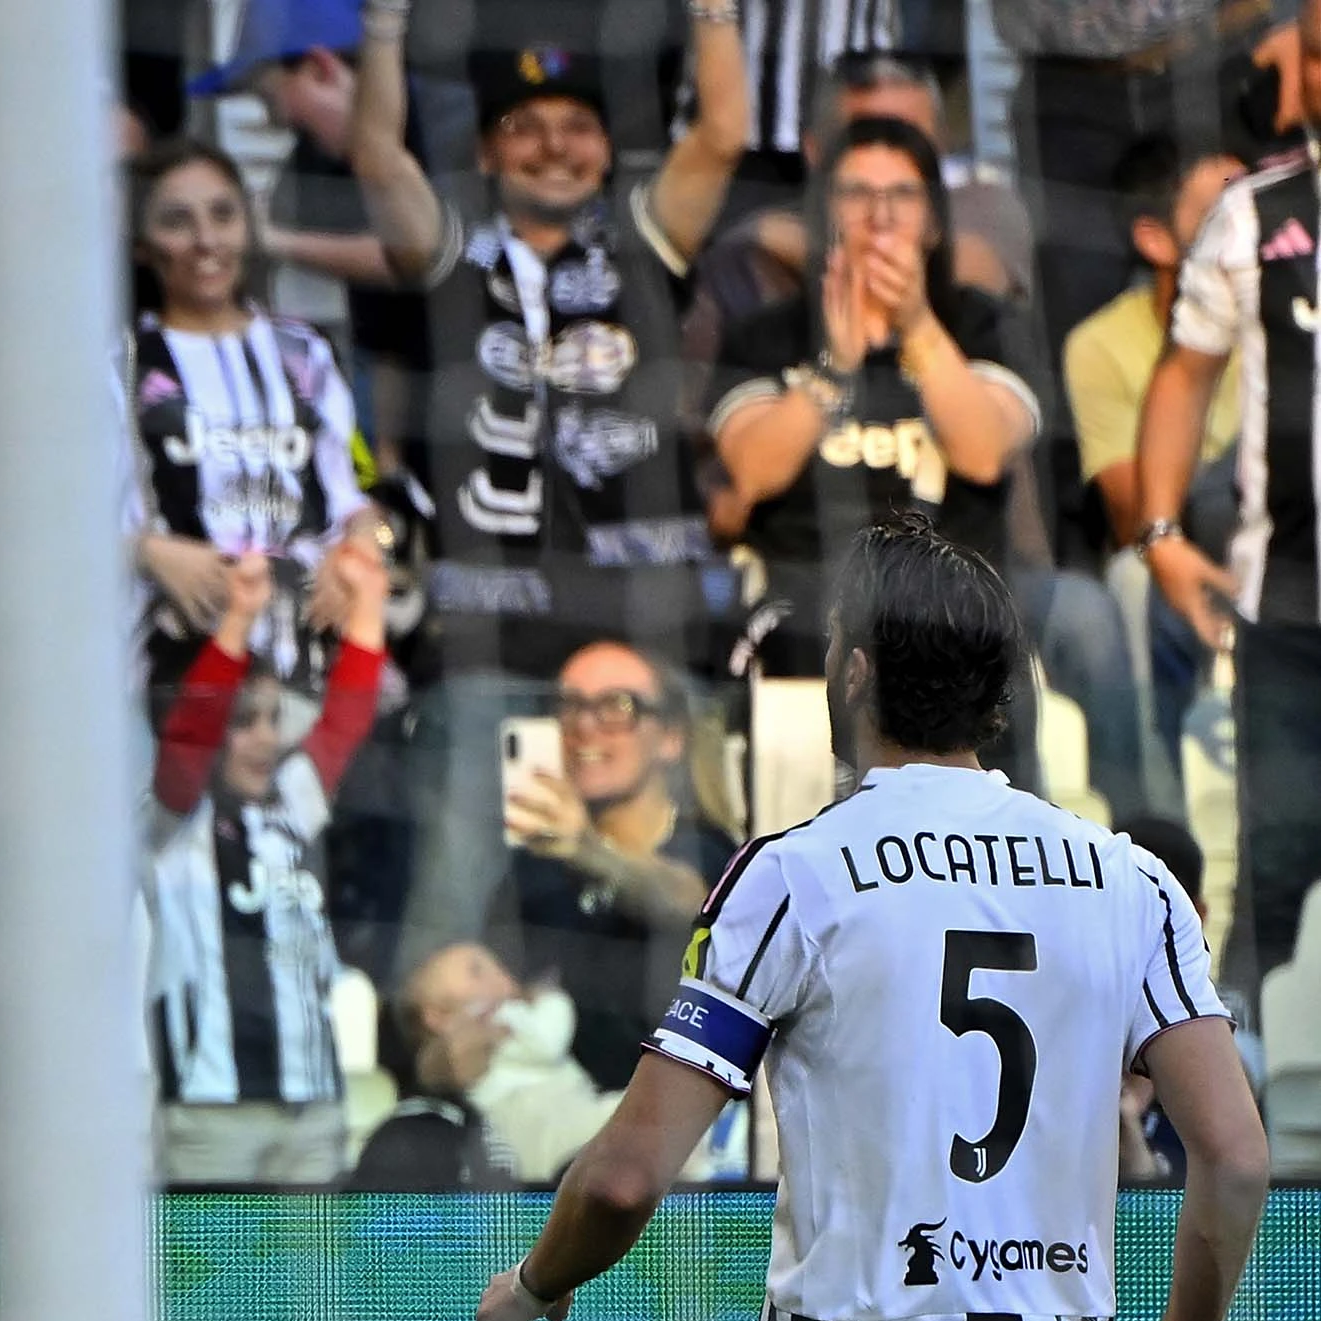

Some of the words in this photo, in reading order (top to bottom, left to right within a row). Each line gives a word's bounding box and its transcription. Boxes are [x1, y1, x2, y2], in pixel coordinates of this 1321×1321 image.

[840, 831, 1105, 894] LOCATELLI
[665, 998, 710, 1030] ACE
[938, 928, 1039, 1184] 5
[949, 1230, 1089, 1282] Cygames
